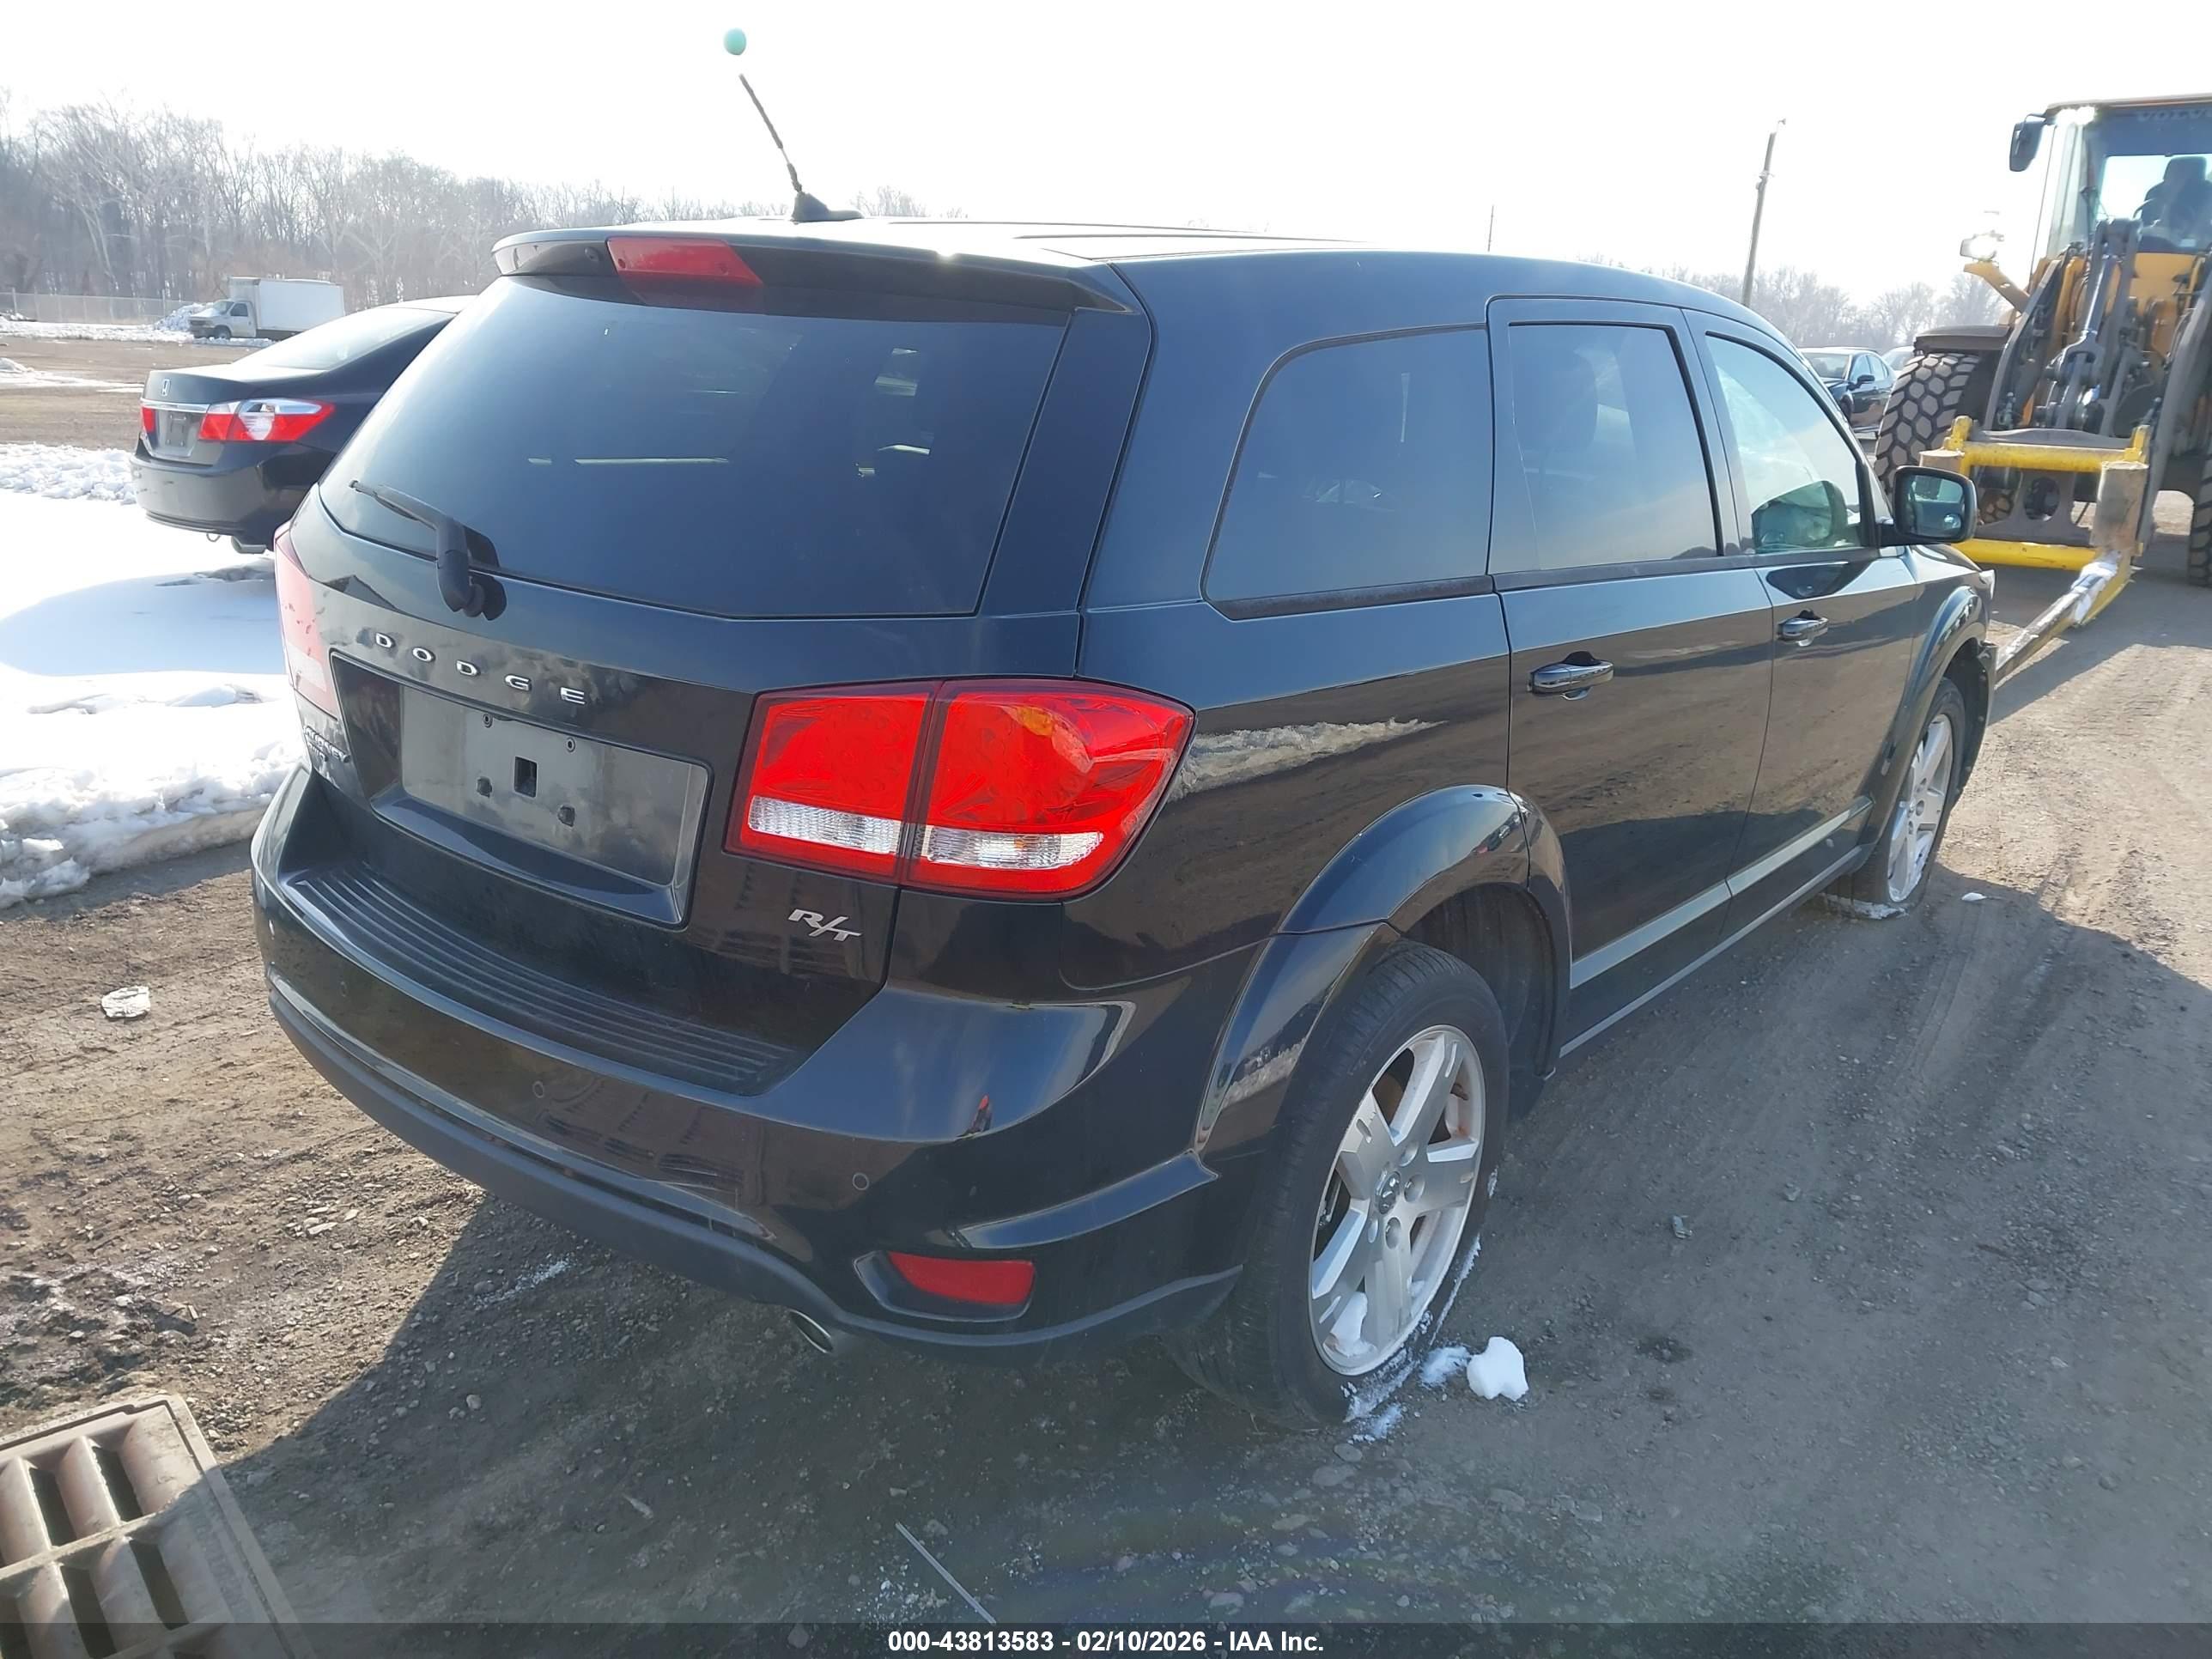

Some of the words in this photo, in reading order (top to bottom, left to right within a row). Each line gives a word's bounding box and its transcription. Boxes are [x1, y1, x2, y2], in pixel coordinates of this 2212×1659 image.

[2136, 108, 2212, 123] VOLV
[374, 632, 586, 706] DODGE
[787, 908, 862, 942] R/T
